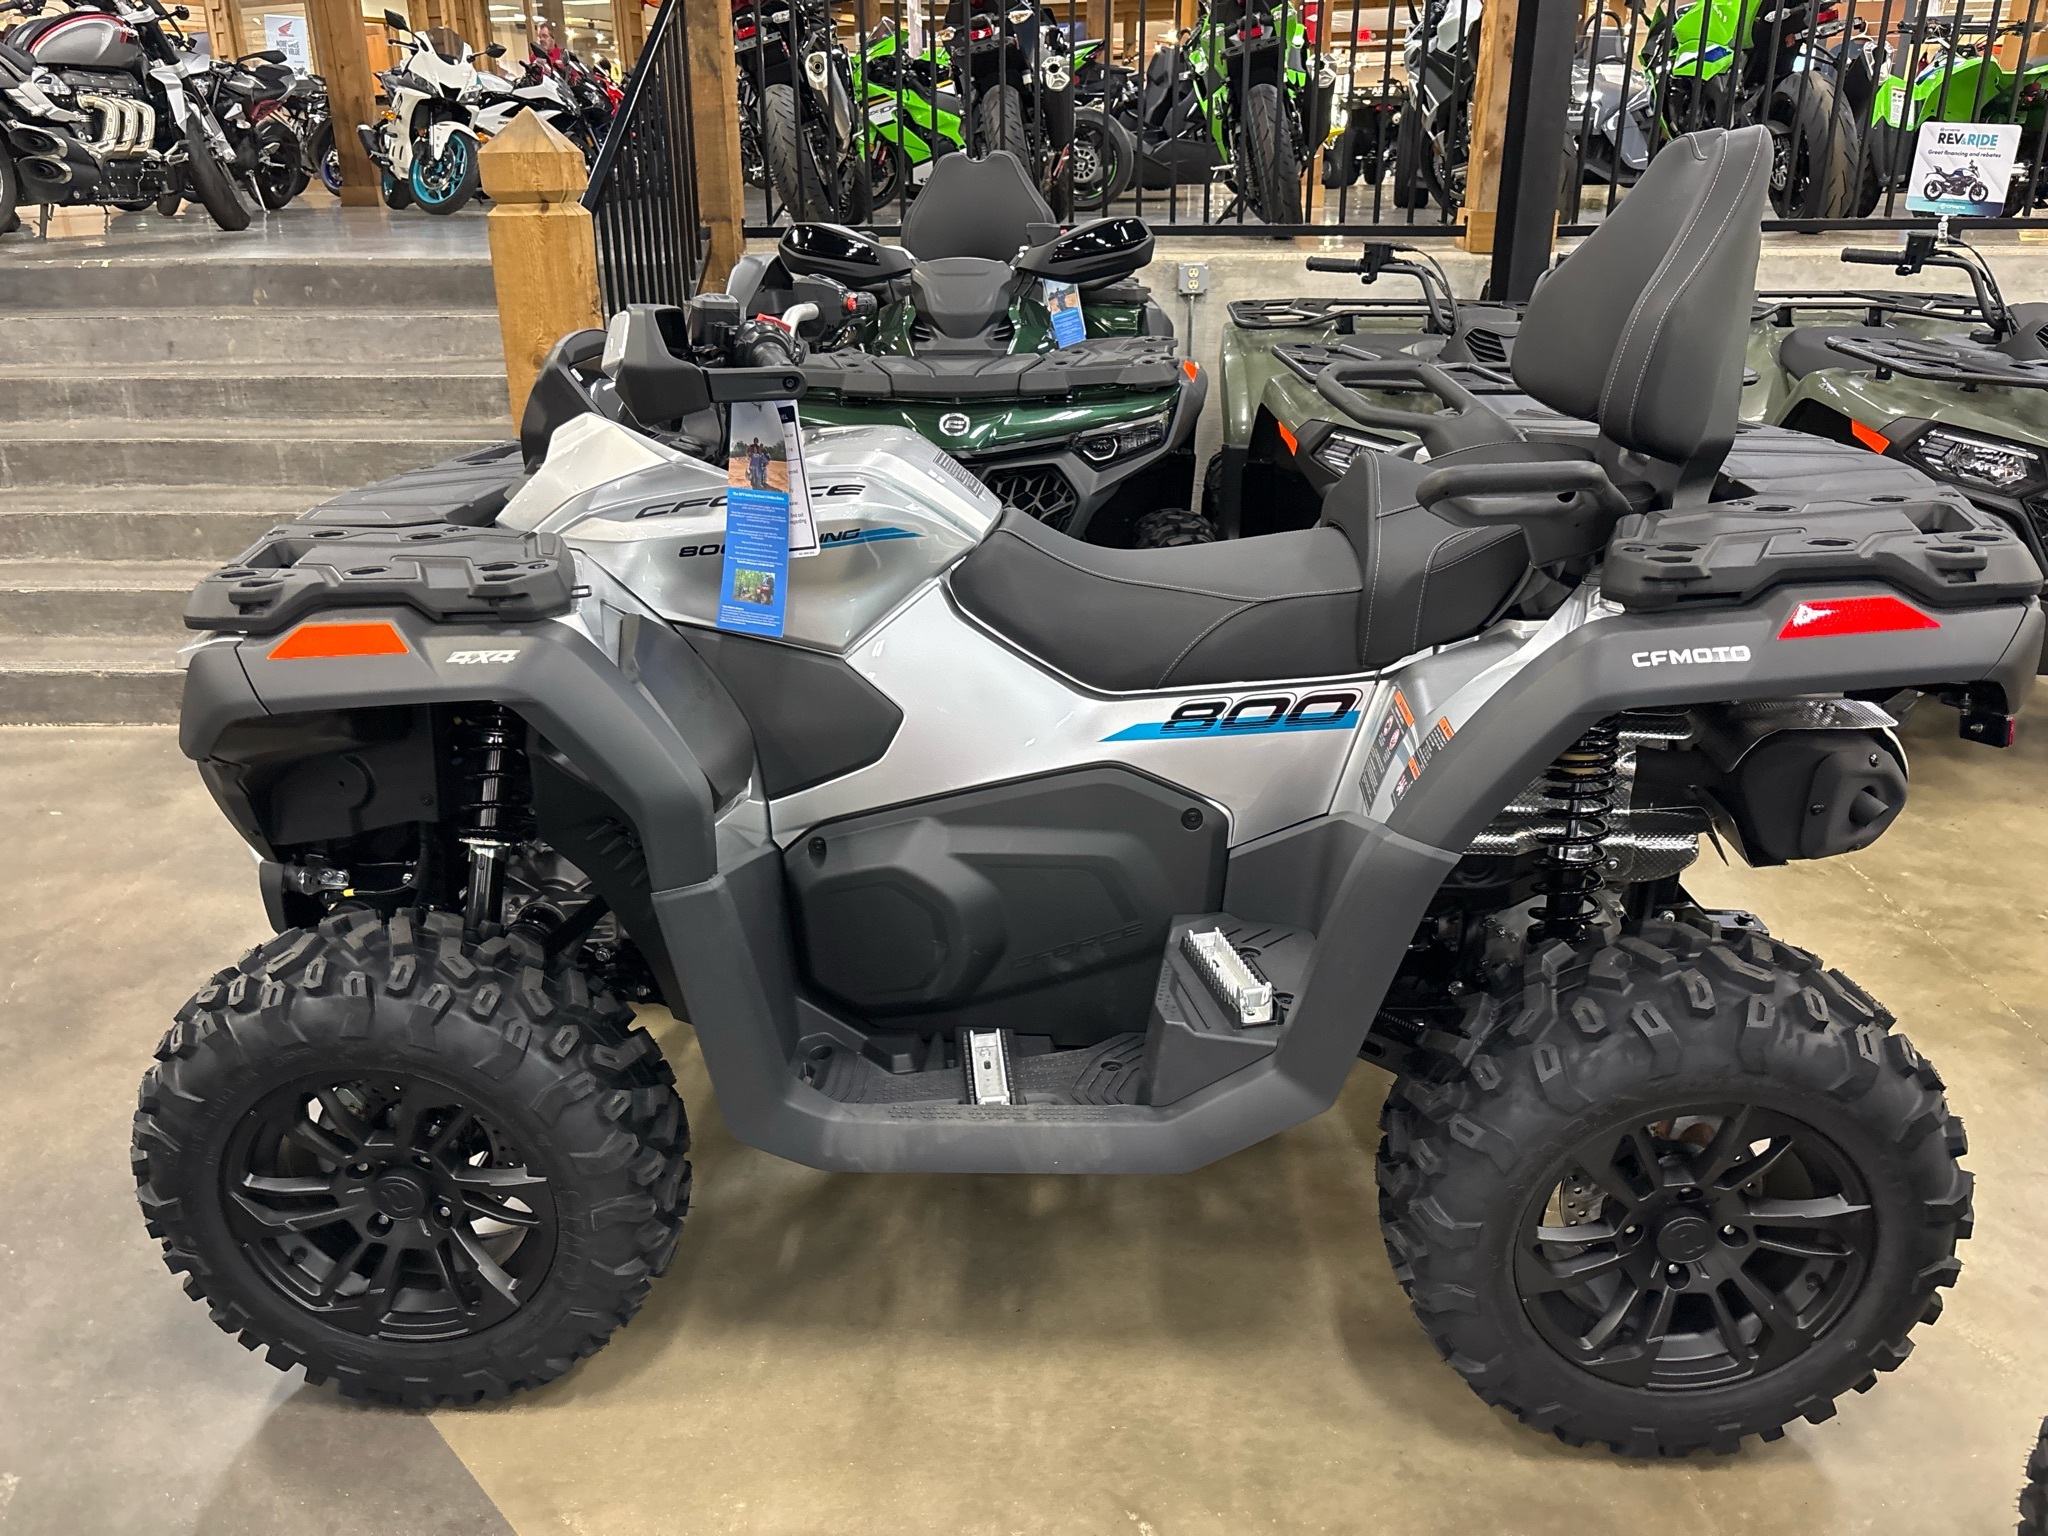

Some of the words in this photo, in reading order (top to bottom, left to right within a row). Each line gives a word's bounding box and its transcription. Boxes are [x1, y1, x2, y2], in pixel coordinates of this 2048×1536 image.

[1944, 150, 1968, 158] financing
[679, 543, 726, 557] 80
[1632, 645, 1751, 667] CFMOTO
[1160, 688, 1363, 735] 800
